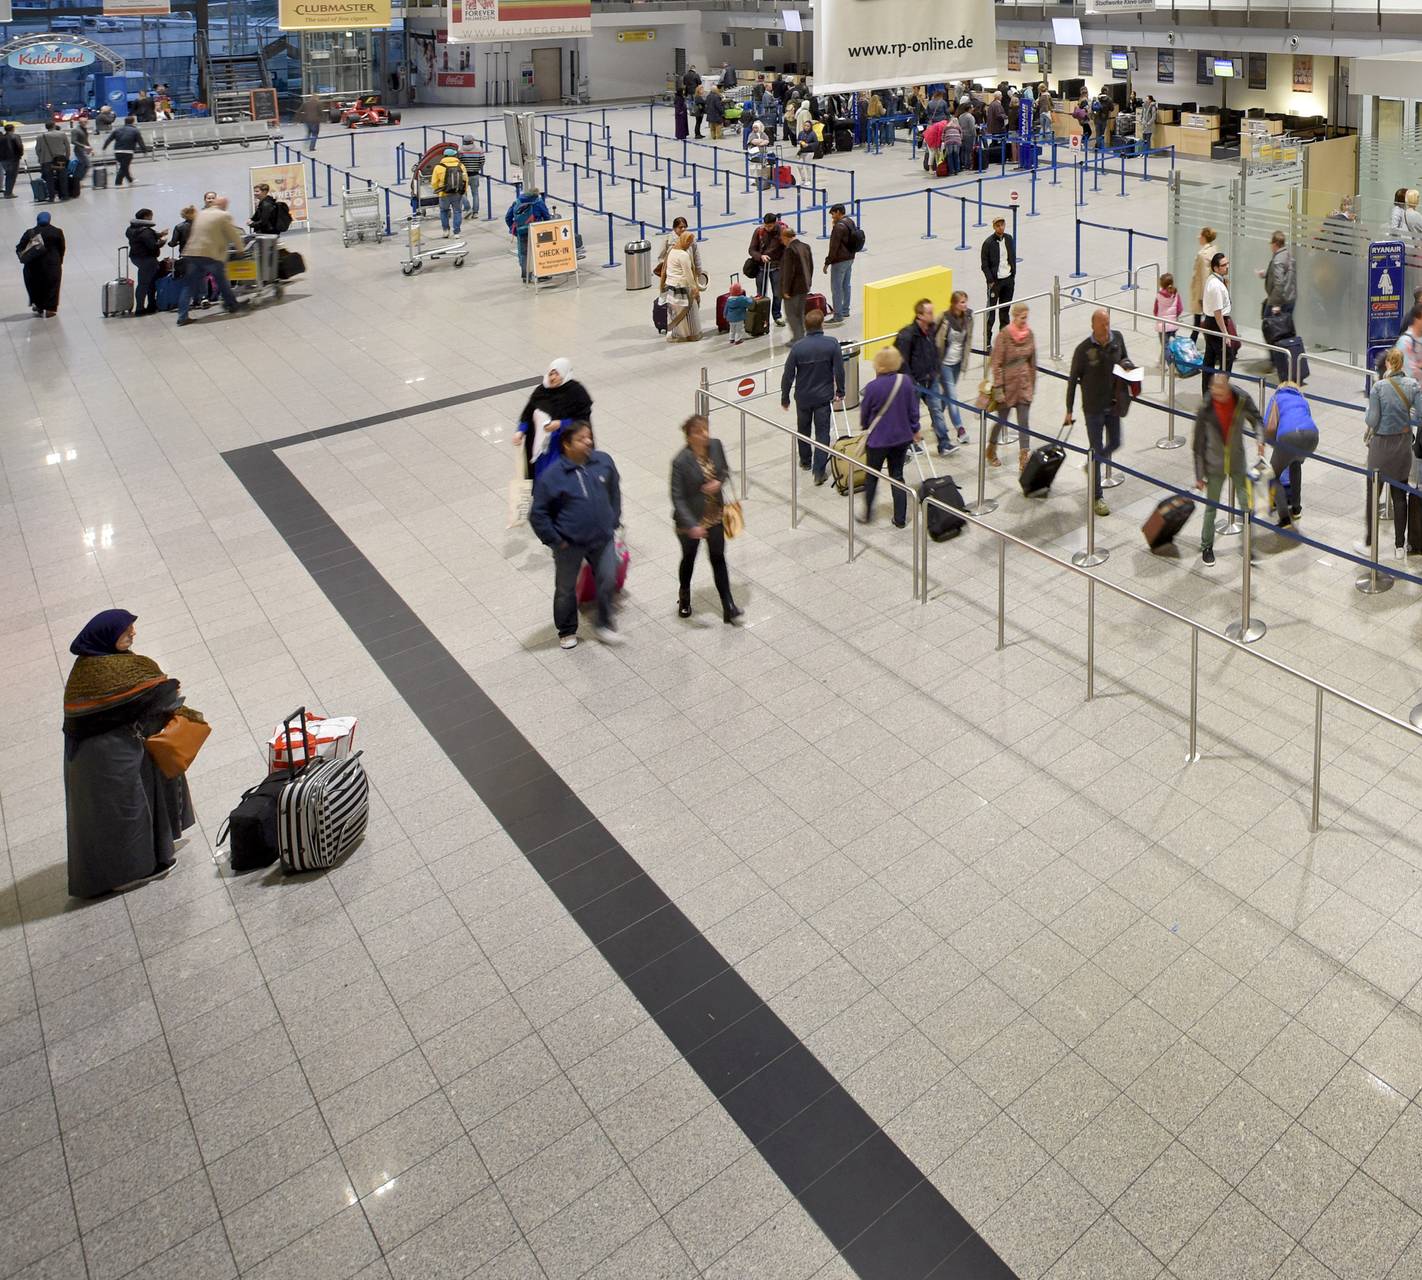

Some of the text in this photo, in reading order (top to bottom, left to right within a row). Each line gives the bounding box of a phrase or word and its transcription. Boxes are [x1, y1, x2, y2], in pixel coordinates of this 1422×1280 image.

[295, 3, 377, 15] CLUBMASTER
[848, 35, 974, 57] www.rp-online.de
[18, 52, 84, 65] Kiddieland
[539, 247, 569, 258] CHECK-IN
